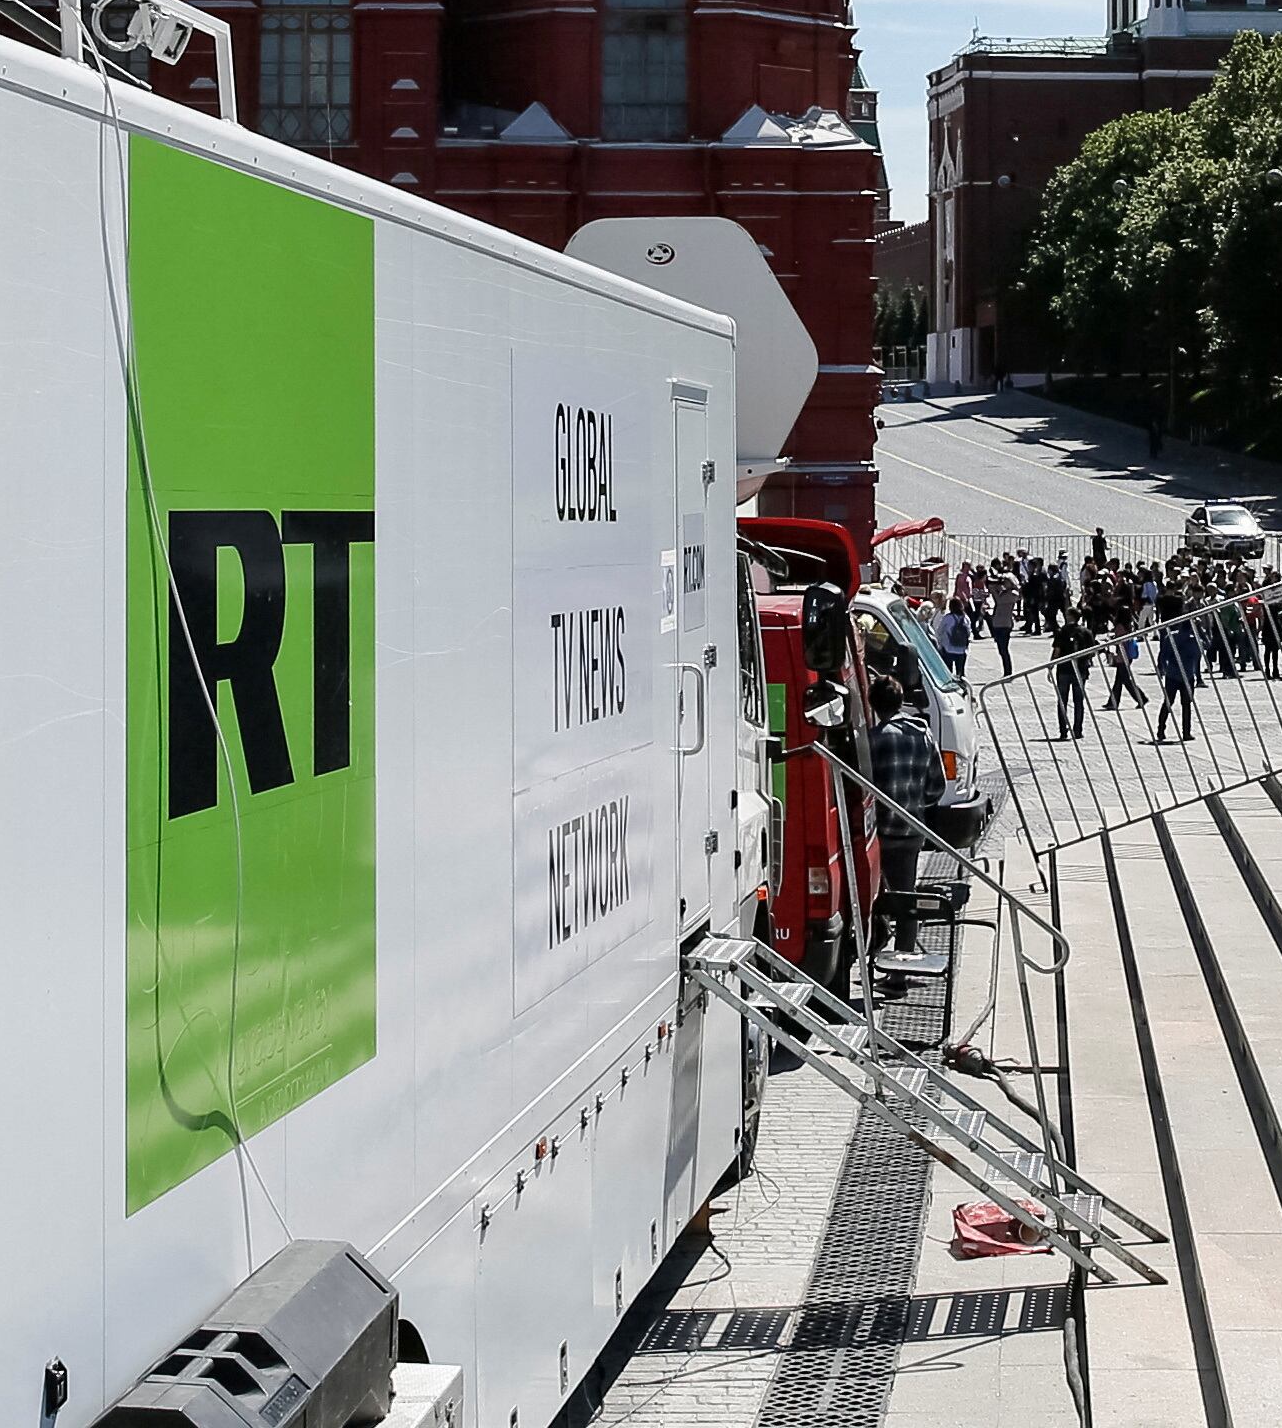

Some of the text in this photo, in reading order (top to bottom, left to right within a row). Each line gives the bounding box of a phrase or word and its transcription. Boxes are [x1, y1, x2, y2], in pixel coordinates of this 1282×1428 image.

[555, 401, 617, 523] GLOBAL
[168, 508, 376, 821] RT
[550, 604, 626, 733] TV NEWS
[548, 794, 631, 950] NETWORK
